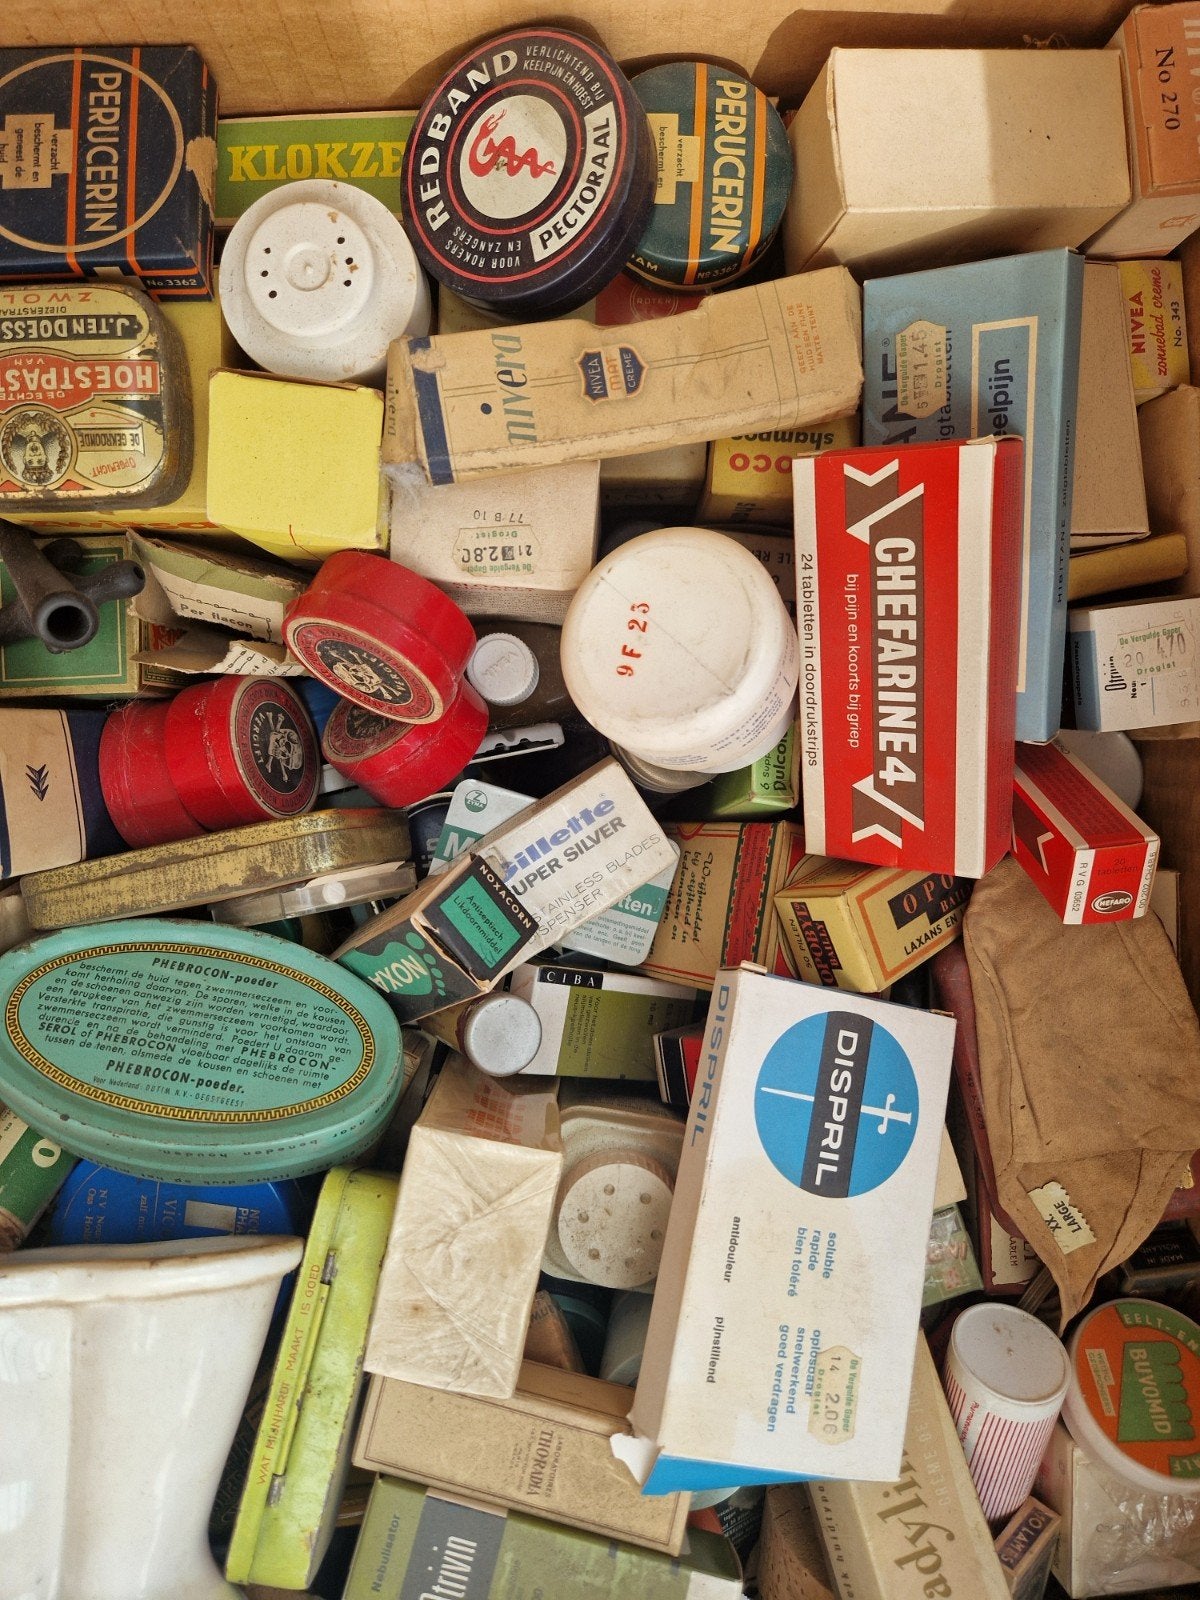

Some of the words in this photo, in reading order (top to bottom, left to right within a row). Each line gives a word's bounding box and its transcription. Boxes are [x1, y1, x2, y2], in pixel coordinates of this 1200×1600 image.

[526, 46, 594, 84] VERLICHTEND
[593, 82, 605, 100] BIJ
[1155, 47, 1175, 83] No
[523, 60, 564, 79] KEELPIJN
[564, 73, 575, 87] EN
[572, 81, 594, 110] HOEST
[1163, 93, 1180, 130] 270
[15, 127, 24, 161] geneest
[34, 122, 44, 169] beschermt
[51, 133, 60, 171] verzacht
[85, 72, 121, 232] PERUCERIN
[658, 126, 668, 174] beschermt
[14, 167, 22, 179] de
[32, 170, 39, 182] en
[539, 117, 610, 249] PECTORAAL
[656, 180, 663, 189] en
[709, 80, 746, 253] PERUCERIN
[445, 239, 485, 268] ROKERS
[452, 226, 502, 252] ZANGERS
[508, 240, 521, 251] EN
[492, 256, 520, 268] VOOR
[1129, 291, 1145, 354] NIVEA
[1171, 301, 1179, 320] 343
[1152, 310, 1167, 376] zonnebad
[1174, 326, 1183, 347] No.
[588, 358, 603, 394] NIVEA
[622, 352, 636, 388] CREME
[795, 343, 806, 374] GEEFT
[50, 391, 65, 399] DE
[79, 433, 127, 447] GEKROONDE
[129, 433, 139, 445] DE
[473, 509, 486, 520] 10
[494, 512, 501, 521] B
[508, 513, 522, 523] 77
[475, 530, 517, 538] Drogist
[800, 553, 813, 575] 24
[846, 574, 858, 591] bij
[179, 603, 205, 616] Per
[210, 611, 254, 629] flacon
[802, 580, 815, 642] tabletten
[846, 594, 858, 620] pijn
[848, 624, 858, 639] en
[1119, 637, 1127, 646] De
[805, 647, 814, 657] in
[848, 641, 860, 692] koorts
[1136, 661, 1176, 676] Drogist
[804, 661, 818, 767] doordrukstrips
[847, 693, 860, 714] bij
[252, 712, 266, 765] VERGIFT
[847, 717, 859, 748] griep
[563, 816, 626, 863] SILVER
[480, 864, 532, 928] NOXACORN
[532, 872, 603, 923] STAINLESS
[606, 833, 661, 873] BLADES
[674, 850, 690, 919] ledematen
[453, 896, 502, 955] Likdoornmiddel
[466, 895, 505, 941] Antiseptisch
[671, 924, 678, 940] en
[904, 927, 944, 956] LAXANS
[945, 912, 958, 927] EN
[681, 931, 687, 943] in
[80, 960, 128, 976] beschermt
[148, 973, 170, 983] huid
[175, 979, 201, 989] tegen
[205, 985, 291, 1005] zwemmerseczeem
[152, 958, 278, 988] PHEBROCON-poeder
[546, 971, 595, 986] CIBA
[38, 1019, 76, 1035] SEROL
[81, 1030, 93, 1038] of
[96, 1031, 176, 1052] PHEBROCON
[182, 1047, 230, 1061] vloeibaar
[233, 1056, 277, 1072] dagelijks
[282, 1065, 295, 1073] de
[299, 1069, 329, 1080] ruimte
[691, 985, 730, 1147] DISPRIL
[106, 1060, 244, 1093] PHEBROCON-poeder.
[814, 1029, 858, 1186] DISPRIL
[1044, 1213, 1062, 1233] XX.
[1054, 1200, 1083, 1234] LARGE
[723, 1216, 741, 1283] antidouleur
[794, 1227, 807, 1255] bien
[808, 1229, 821, 1271] rapide
[822, 1232, 837, 1279] soluble
[305, 1264, 321, 1300] GOED
[787, 1256, 800, 1297] toléré
[301, 1302, 311, 1316] IS
[285, 1327, 305, 1371] MAAKT
[706, 1316, 723, 1384] pijnstillend
[776, 1324, 790, 1359] goed
[785, 1327, 805, 1415] snelwerkend
[767, 1363, 784, 1432] verdragen
[1129, 1347, 1172, 1435] BUVOMID
[266, 1379, 291, 1450] MIJNHARDT
[256, 1454, 272, 1485] WAT
[526, 1429, 554, 1496] THORADIA
[371, 1513, 401, 1593] Nebulisator
